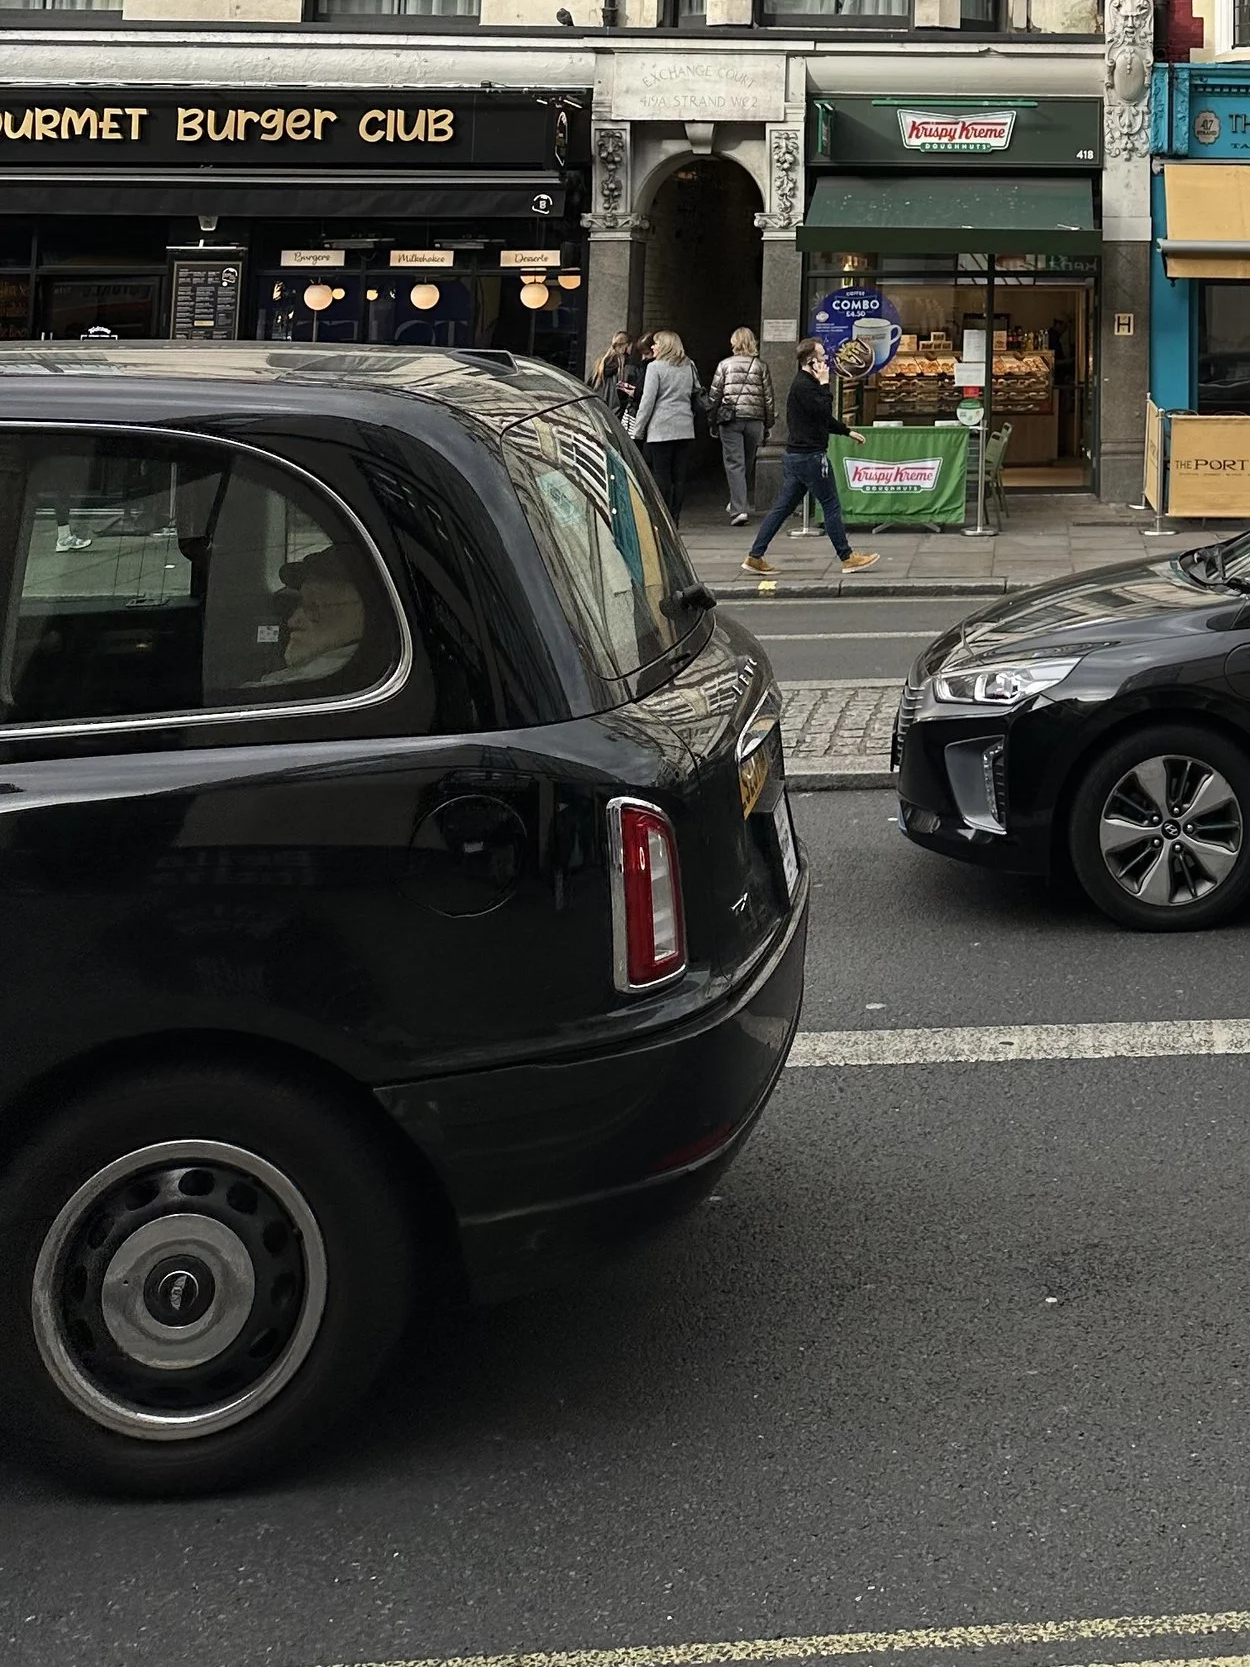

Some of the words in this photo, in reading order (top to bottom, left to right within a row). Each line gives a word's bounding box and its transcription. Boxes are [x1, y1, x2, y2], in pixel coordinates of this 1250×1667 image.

[642, 65, 713, 87] EXCHANGE
[717, 67, 757, 89] COURT
[673, 95, 726, 108] STRAND
[0, 107, 147, 141] URMET
[907, 120, 961, 142] Krispy
[957, 120, 1009, 140] Kreme
[1076, 150, 1094, 160] 418
[832, 299, 880, 311] COMBO
[1175, 460, 1193, 469] THE
[1194, 458, 1249, 470] PORT
[852, 465, 895, 485] Krispy
[893, 465, 935, 483] Kreme
